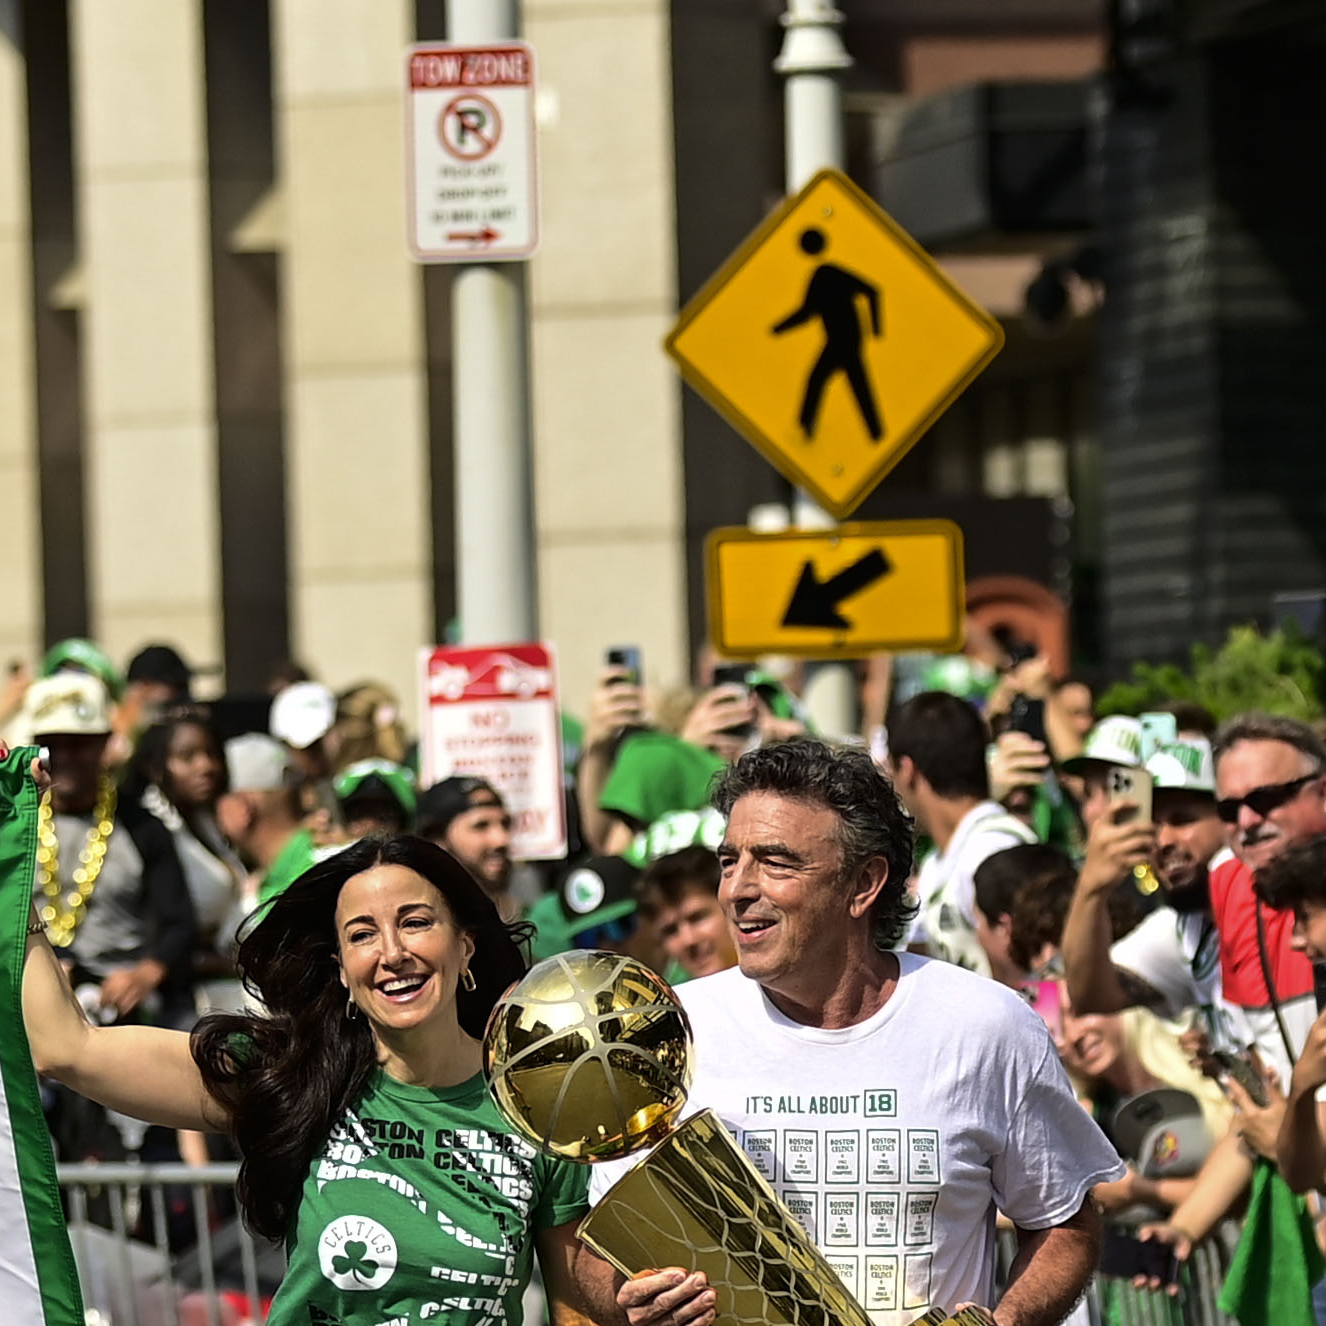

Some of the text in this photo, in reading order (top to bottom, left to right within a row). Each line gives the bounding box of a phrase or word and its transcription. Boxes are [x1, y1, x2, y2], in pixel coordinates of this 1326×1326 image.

[412, 52, 529, 86] TOW ZONE
[745, 1094, 893, 1114] IT'S ALL ABOUT 18
[322, 1139, 425, 1164] BOTON
[324, 1221, 393, 1255] CELTICS
